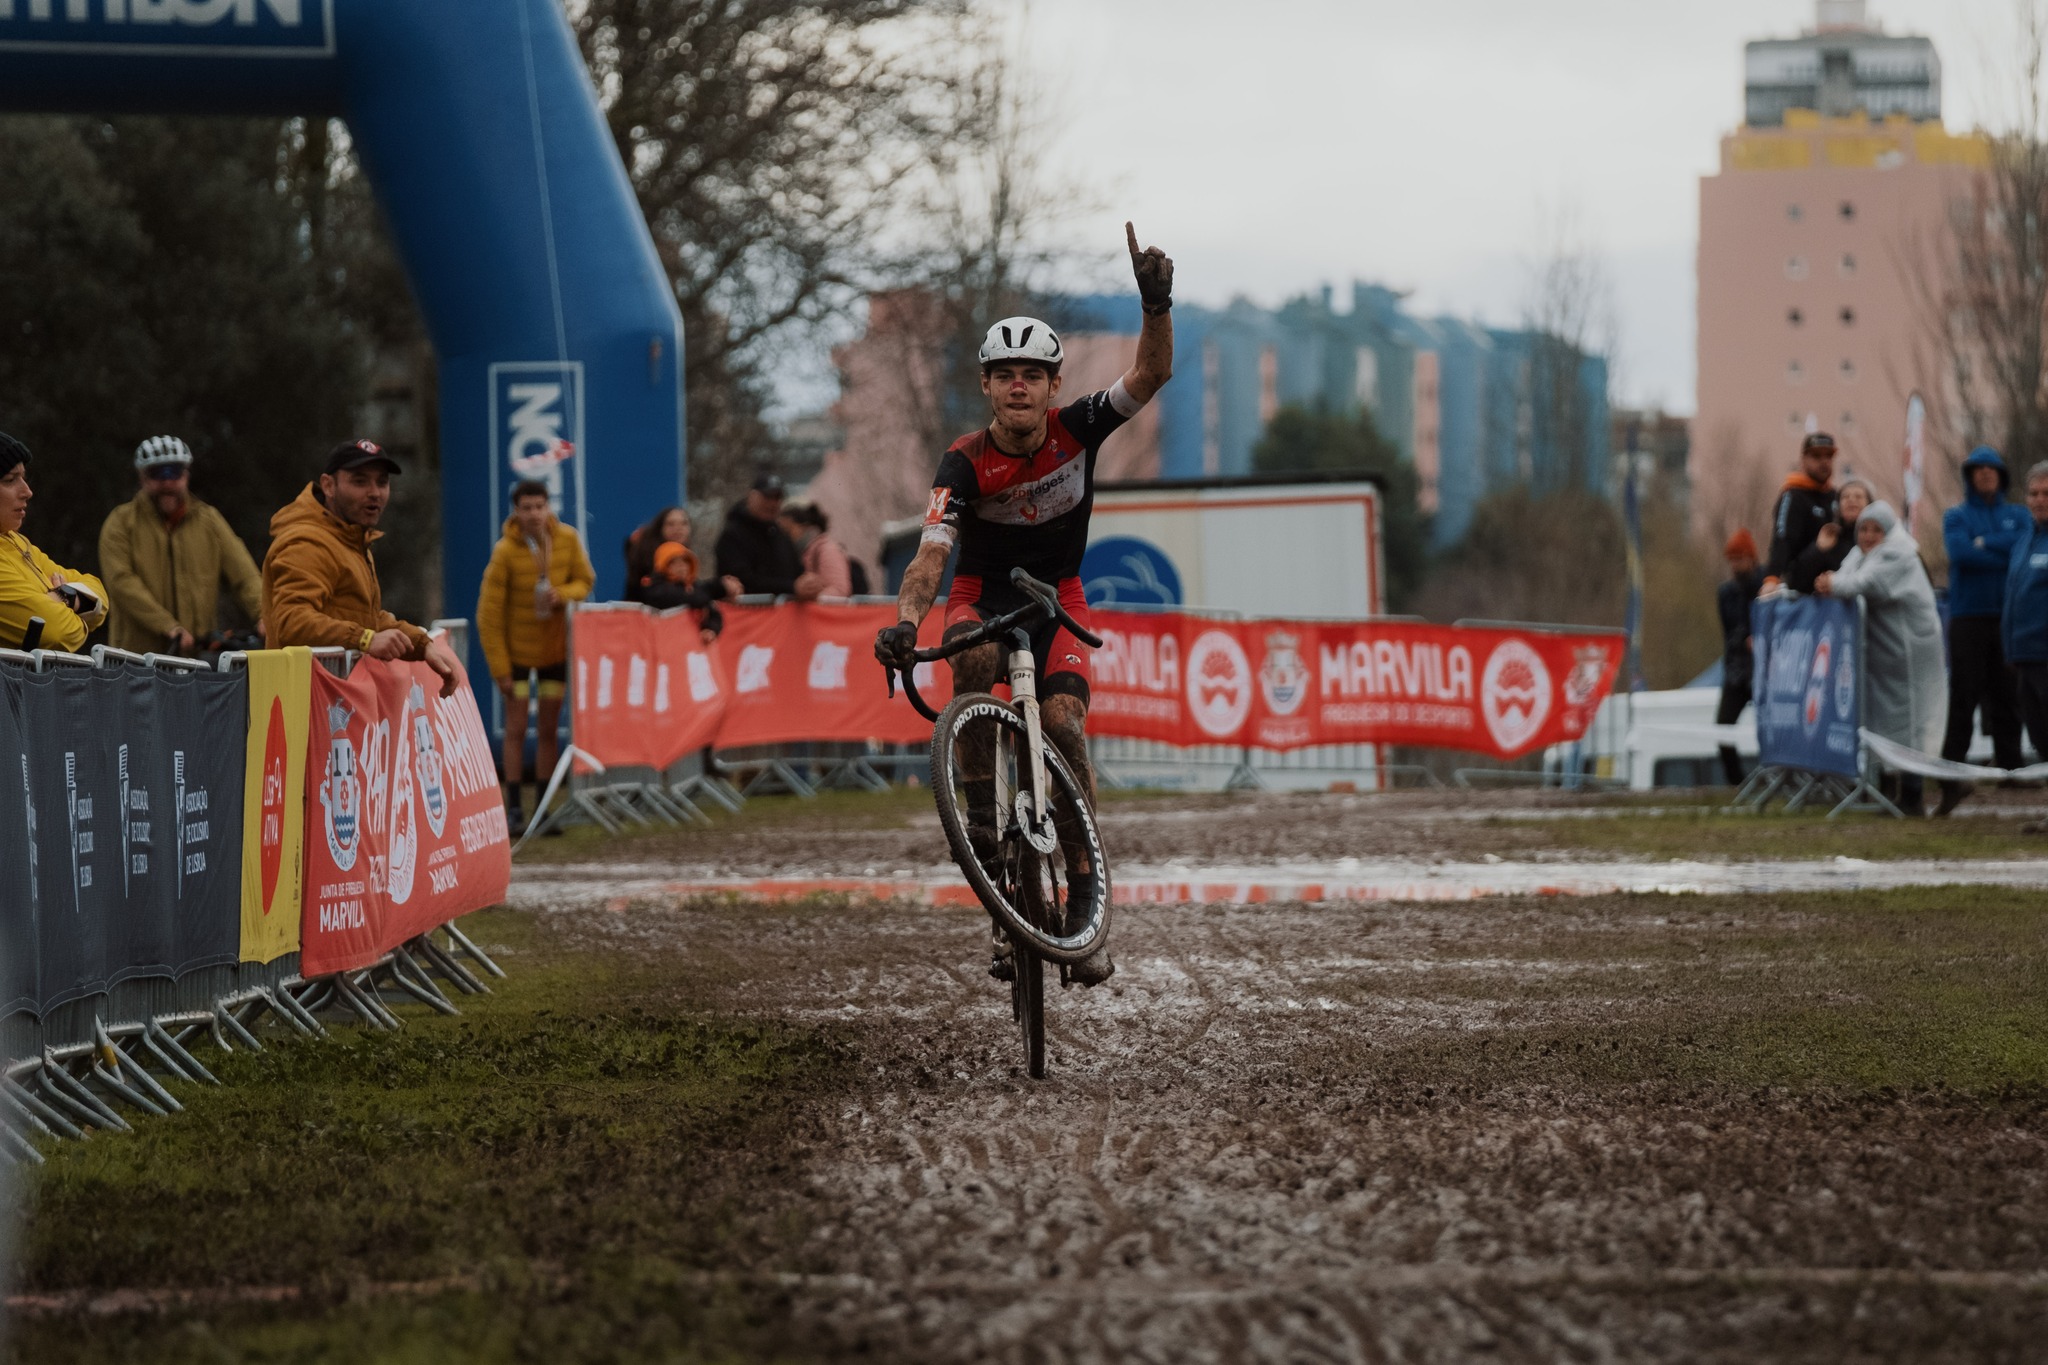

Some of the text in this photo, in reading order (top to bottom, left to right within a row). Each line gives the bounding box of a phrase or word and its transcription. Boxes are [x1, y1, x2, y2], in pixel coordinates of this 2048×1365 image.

[1014, 672, 1031, 680] BH
[1320, 640, 1473, 700] MARVILA
[952, 703, 1028, 737] PROTOTYPE
[1075, 798, 1107, 926] PROTOTYPE
[319, 884, 338, 899] JUNTA
[338, 882, 344, 897] DE
[319, 899, 365, 933] MARVILA
